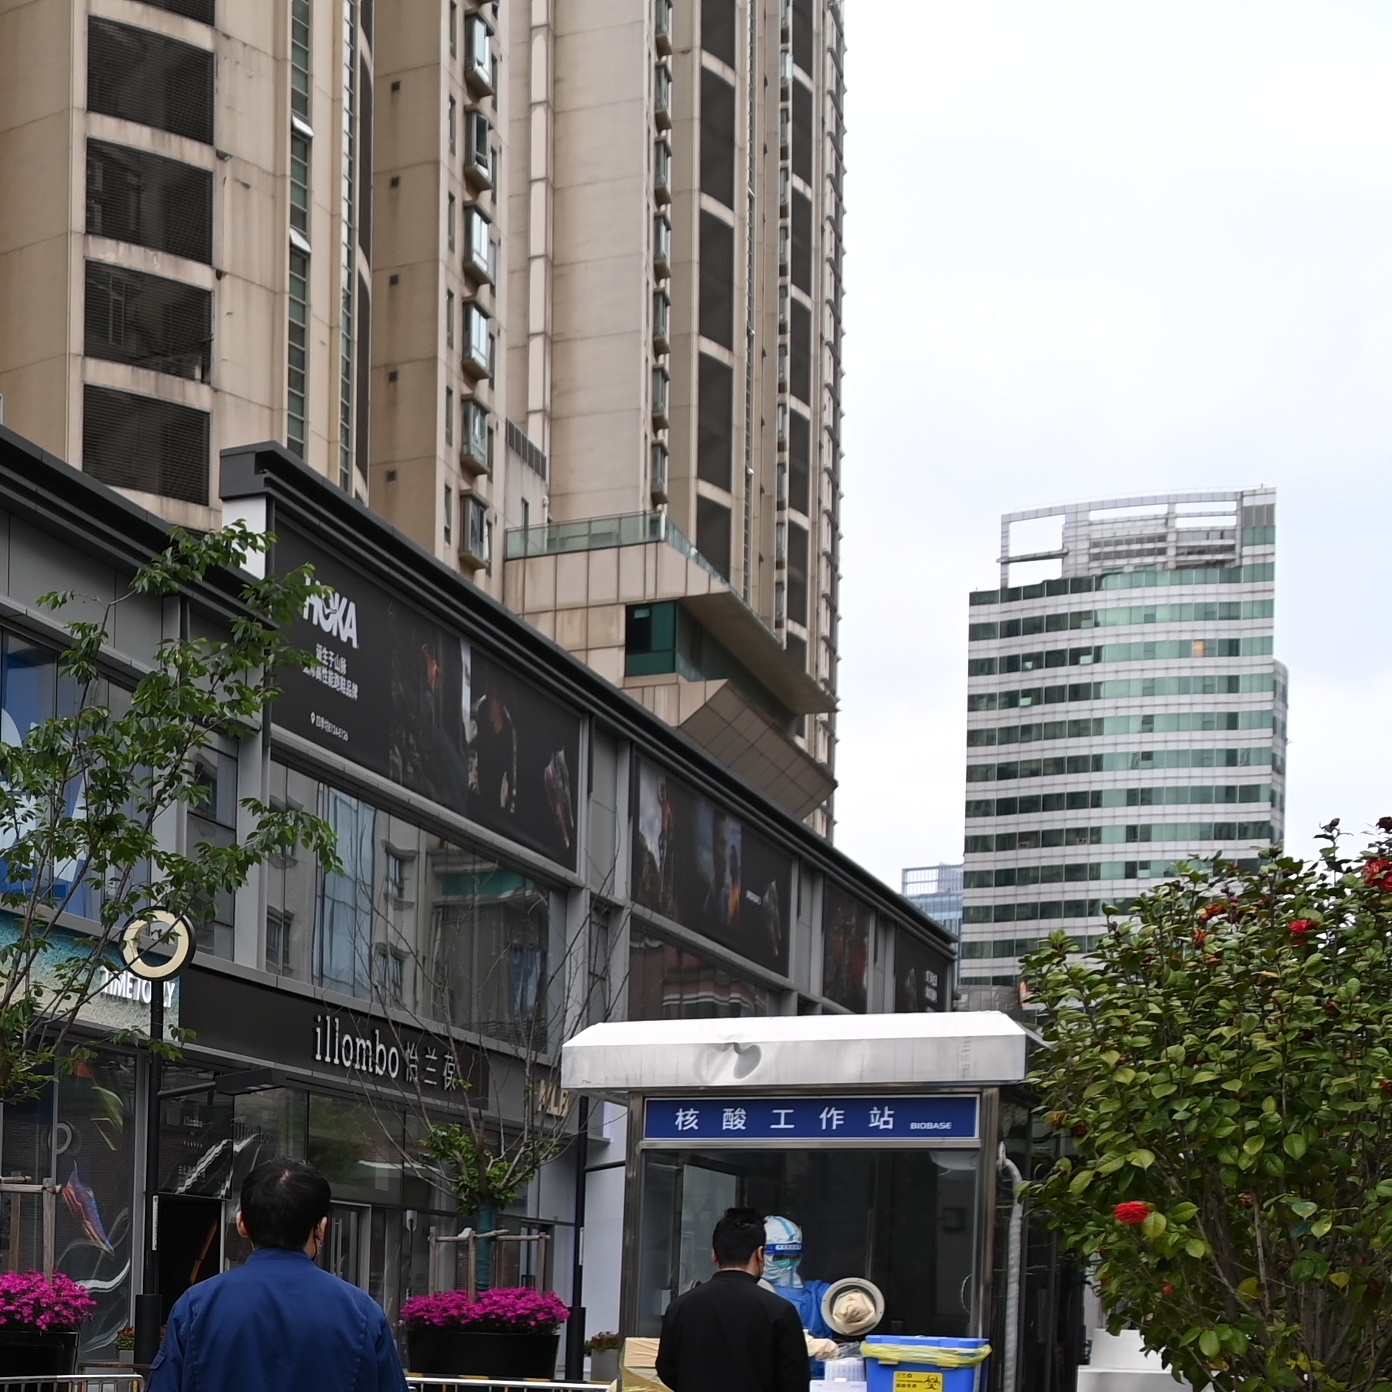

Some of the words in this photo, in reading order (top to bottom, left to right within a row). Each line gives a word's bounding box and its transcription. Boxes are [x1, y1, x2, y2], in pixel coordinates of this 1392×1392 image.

[316, 1015, 400, 1079] illombo
[675, 1106, 895, 1131] 核酸工作站
[910, 1121, 952, 1130] BIOBASE
